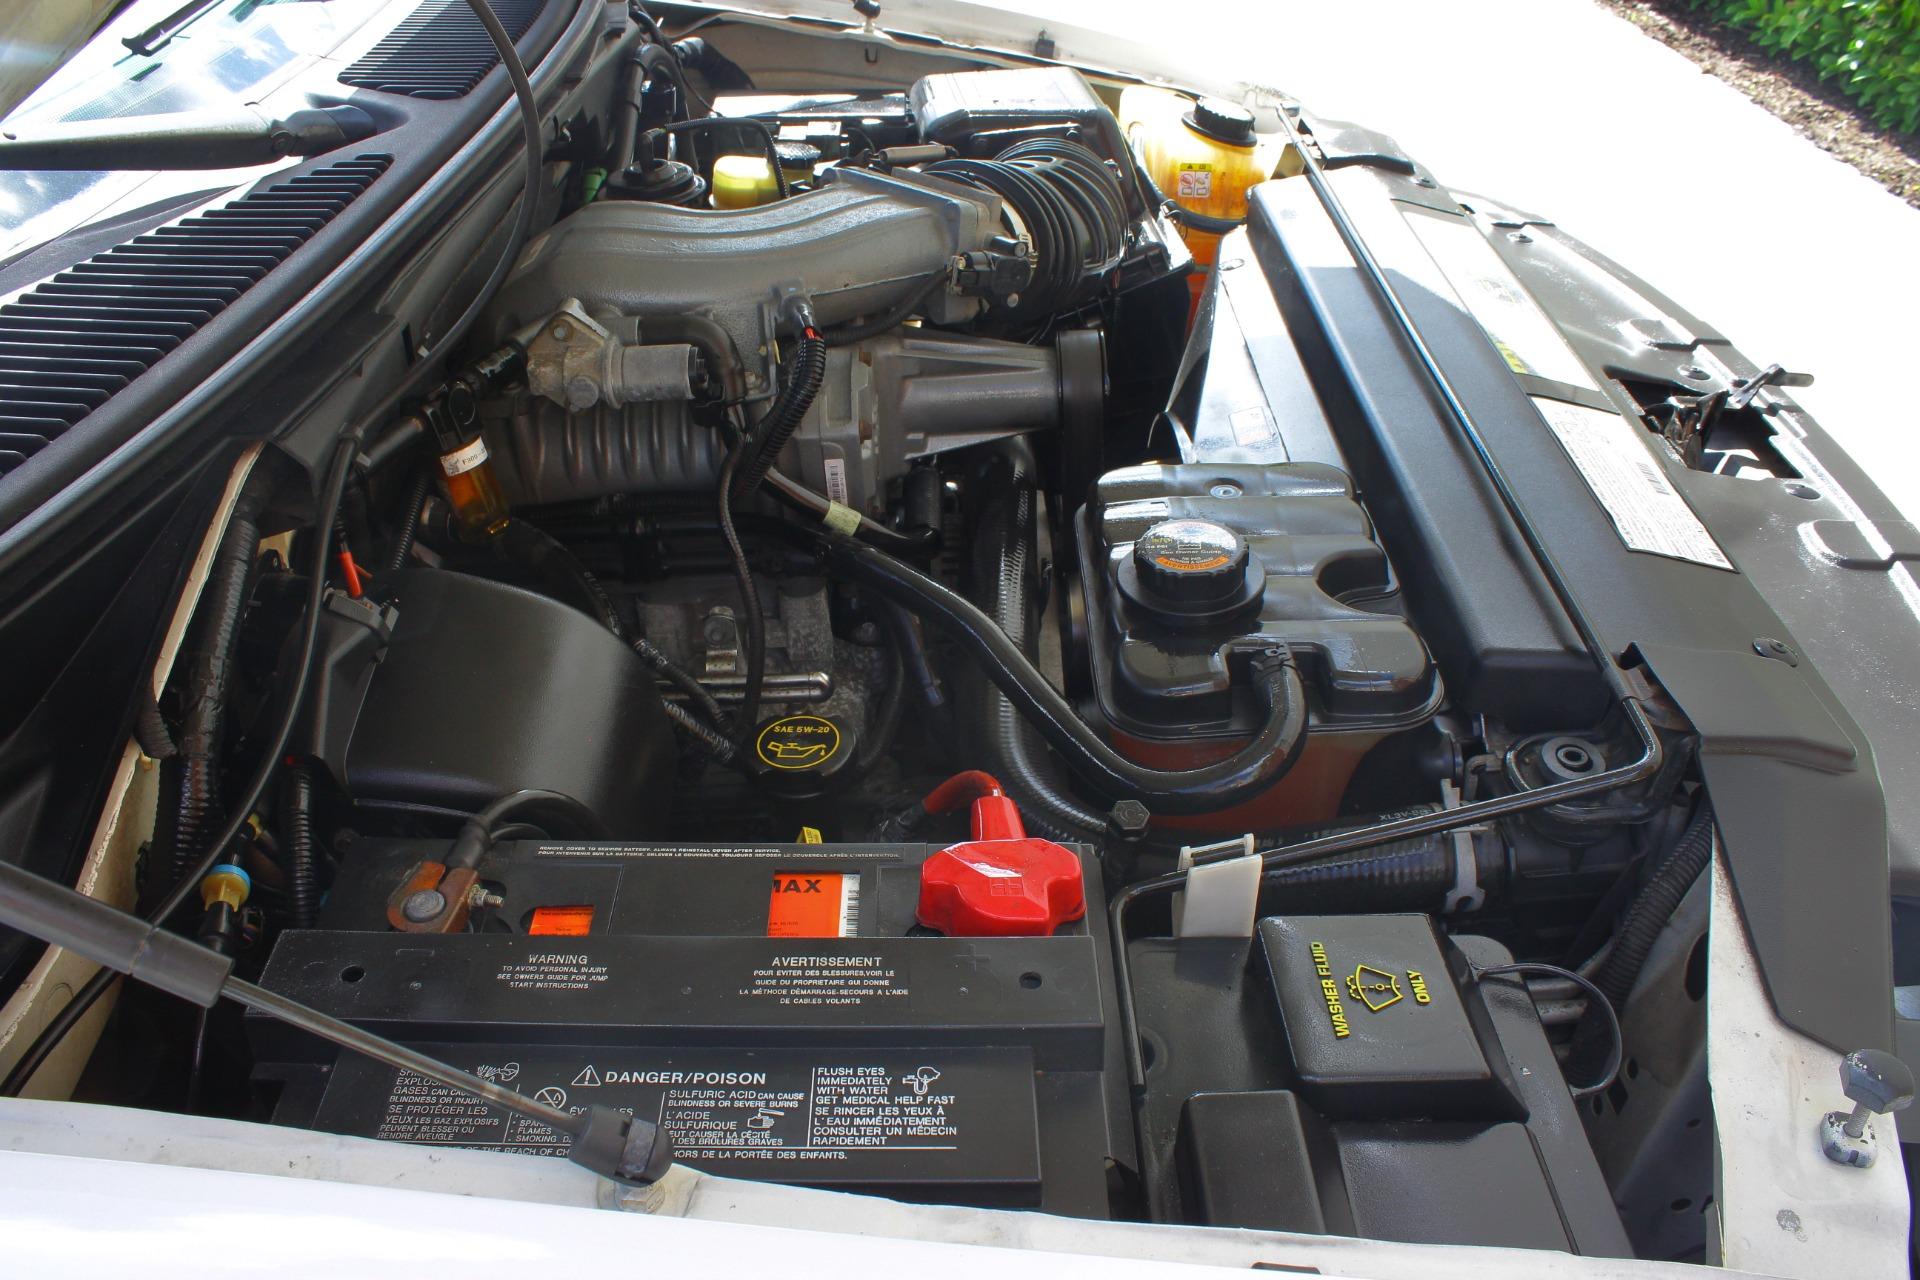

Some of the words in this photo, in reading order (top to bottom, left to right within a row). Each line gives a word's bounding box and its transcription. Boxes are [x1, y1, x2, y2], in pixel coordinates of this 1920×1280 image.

[774, 725, 794, 733] SAE
[529, 954, 588, 965] WARNING
[772, 956, 882, 967] AVERTISSEMENT
[1310, 941, 1332, 976] FLUID
[1406, 969, 1431, 1004] ONLY
[1321, 979, 1350, 1038] WASHER
[817, 1068, 852, 1076] FLUSH
[857, 1068, 885, 1076] EYES
[605, 1071, 766, 1085] DANGER/POISON
[817, 1077, 893, 1085] IMMEDIATELY
[393, 1086, 429, 1096] GASES
[431, 1088, 449, 1096] CAN
[669, 1090, 727, 1099] SULFURIC
[729, 1090, 756, 1099] ACID
[816, 1086, 846, 1095] WITH
[849, 1086, 889, 1095] WATER
[389, 1095, 437, 1104] BLINDNESS
[439, 1096, 452, 1104] OR
[668, 1099, 716, 1107] BLINDNESS
[733, 1100, 768, 1108] SEVERE
[815, 1096, 840, 1105] GET
[843, 1096, 890, 1105] MEDICAL
[894, 1096, 924, 1105] HELP
[927, 1096, 956, 1105] FAST
[388, 1105, 402, 1113] SE
[406, 1103, 466, 1114] PROTÉGER
[468, 1106, 489, 1115] LES
[814, 1107, 829, 1116] SE
[833, 1107, 874, 1116] RINCER
[878, 1107, 900, 1116] LES
[904, 1107, 933, 1116] YEUX
[937, 1104, 945, 1116] À
[386, 1116, 414, 1124] YEUX
[435, 1117, 452, 1125] GAZ
[454, 1117, 500, 1126] EXPLOSIFS
[664, 1120, 738, 1130] SULFURIQUE
[853, 1115, 947, 1126] IMMÉDIATEMENT
[379, 1124, 418, 1132] PEUVENT
[420, 1125, 460, 1133] BLESSER
[517, 1128, 553, 1136] FLAMES
[741, 1129, 771, 1138] CÉCITÉ
[814, 1127, 883, 1136] CONSULTER
[886, 1127, 903, 1136] UN
[907, 1124, 958, 1136] MÉDECIN
[515, 1135, 557, 1143] SMOKING
[698, 1136, 745, 1146] BRÛLURES
[748, 1139, 784, 1147] GRAVES
[813, 1136, 888, 1145] RAPIDEMENT
[505, 1148, 537, 1156] REACH
[702, 1151, 715, 1159] DE
[718, 1151, 731, 1159] LA
[734, 1149, 774, 1159] PORTÉE
[776, 1151, 797, 1160] DES
[799, 1151, 847, 1160] ENFANTS.
